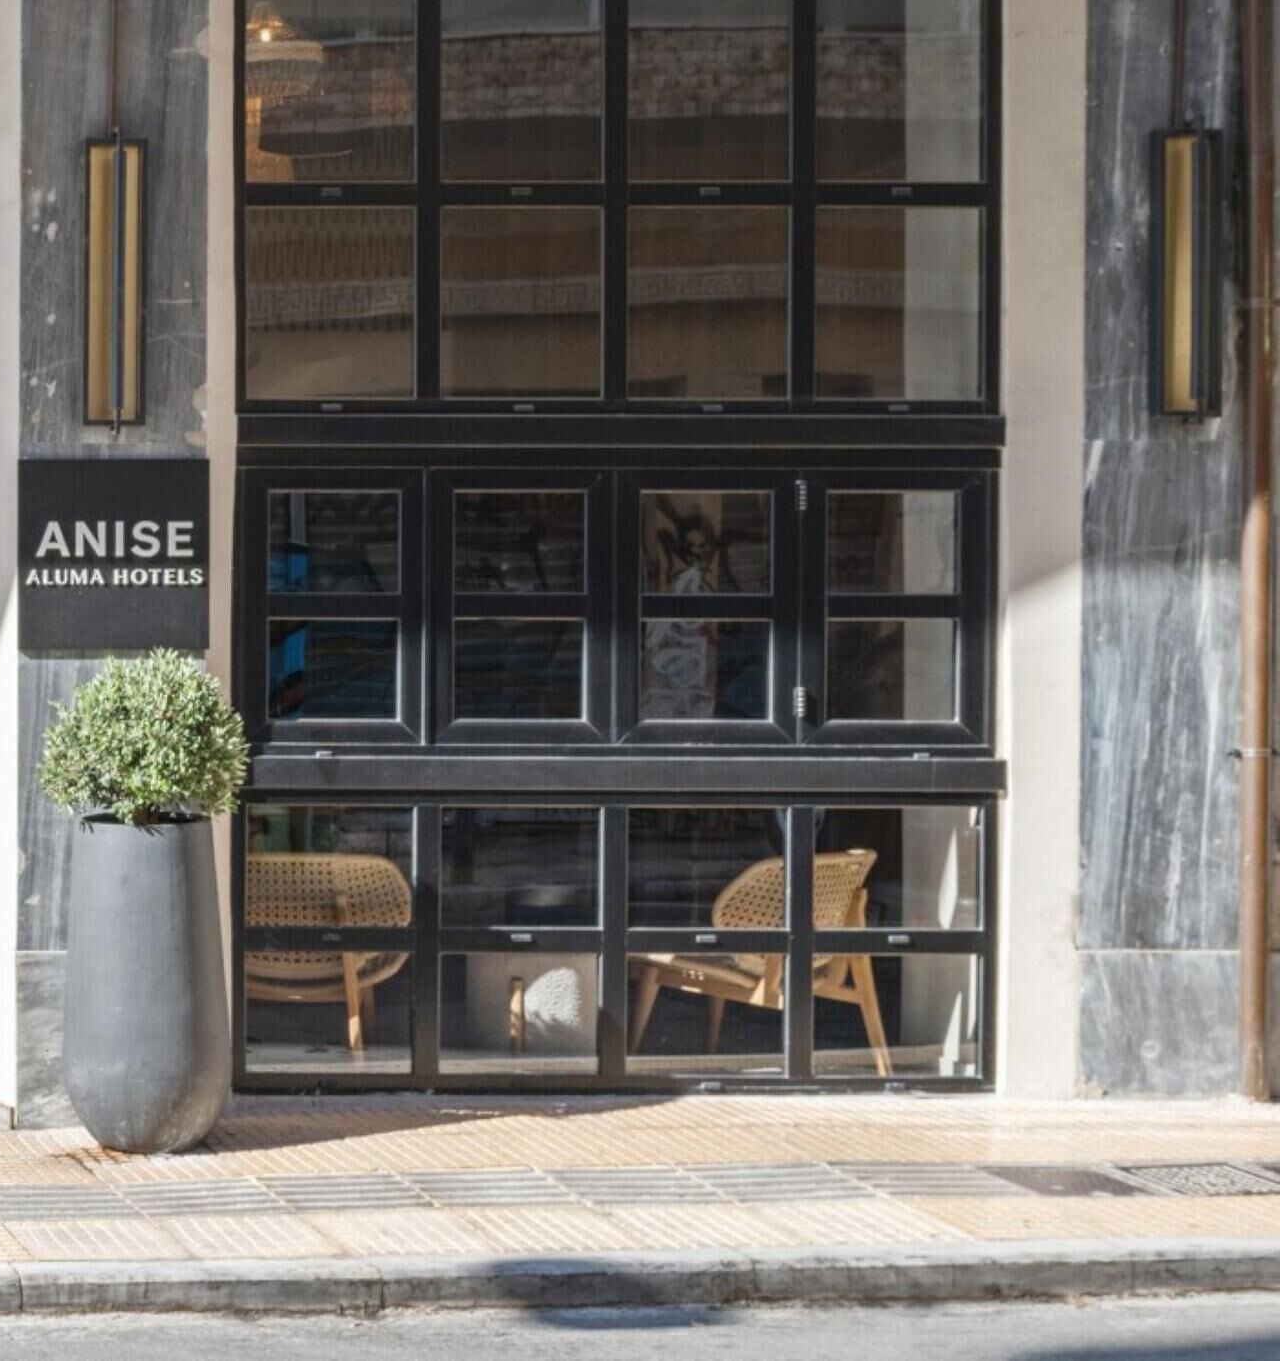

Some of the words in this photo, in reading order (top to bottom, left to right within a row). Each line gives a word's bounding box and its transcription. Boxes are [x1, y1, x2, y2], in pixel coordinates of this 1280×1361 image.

[35, 519, 195, 559] ANISE
[25, 568, 105, 586] ALUMA
[113, 568, 204, 586] HOTELS
